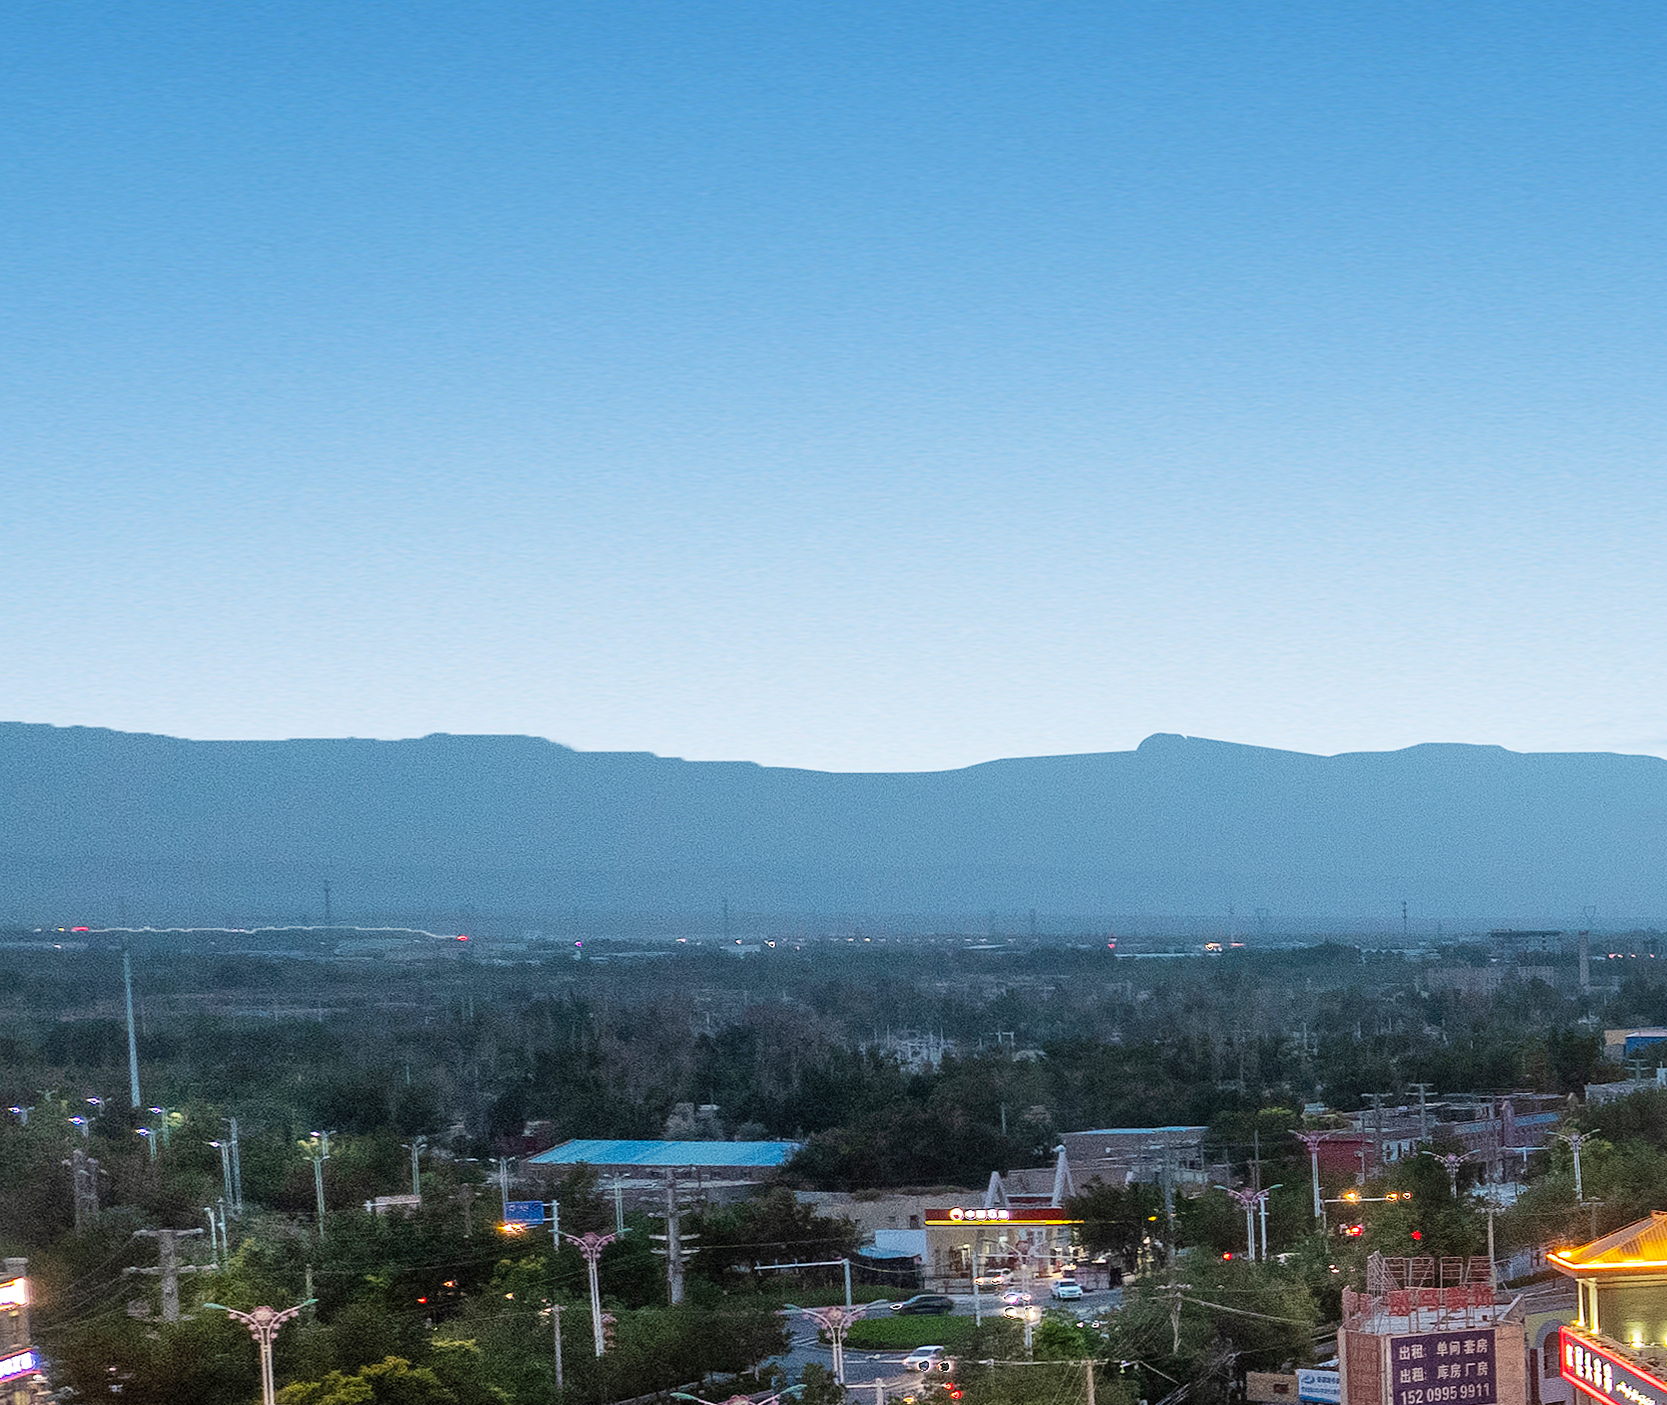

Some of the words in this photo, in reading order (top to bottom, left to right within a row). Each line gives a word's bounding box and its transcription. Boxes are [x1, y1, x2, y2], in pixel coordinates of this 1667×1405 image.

[1400, 1389, 1424, 1405] 152
[1426, 1385, 1458, 1402] 0995
[1459, 1382, 1490, 1399] 9911
